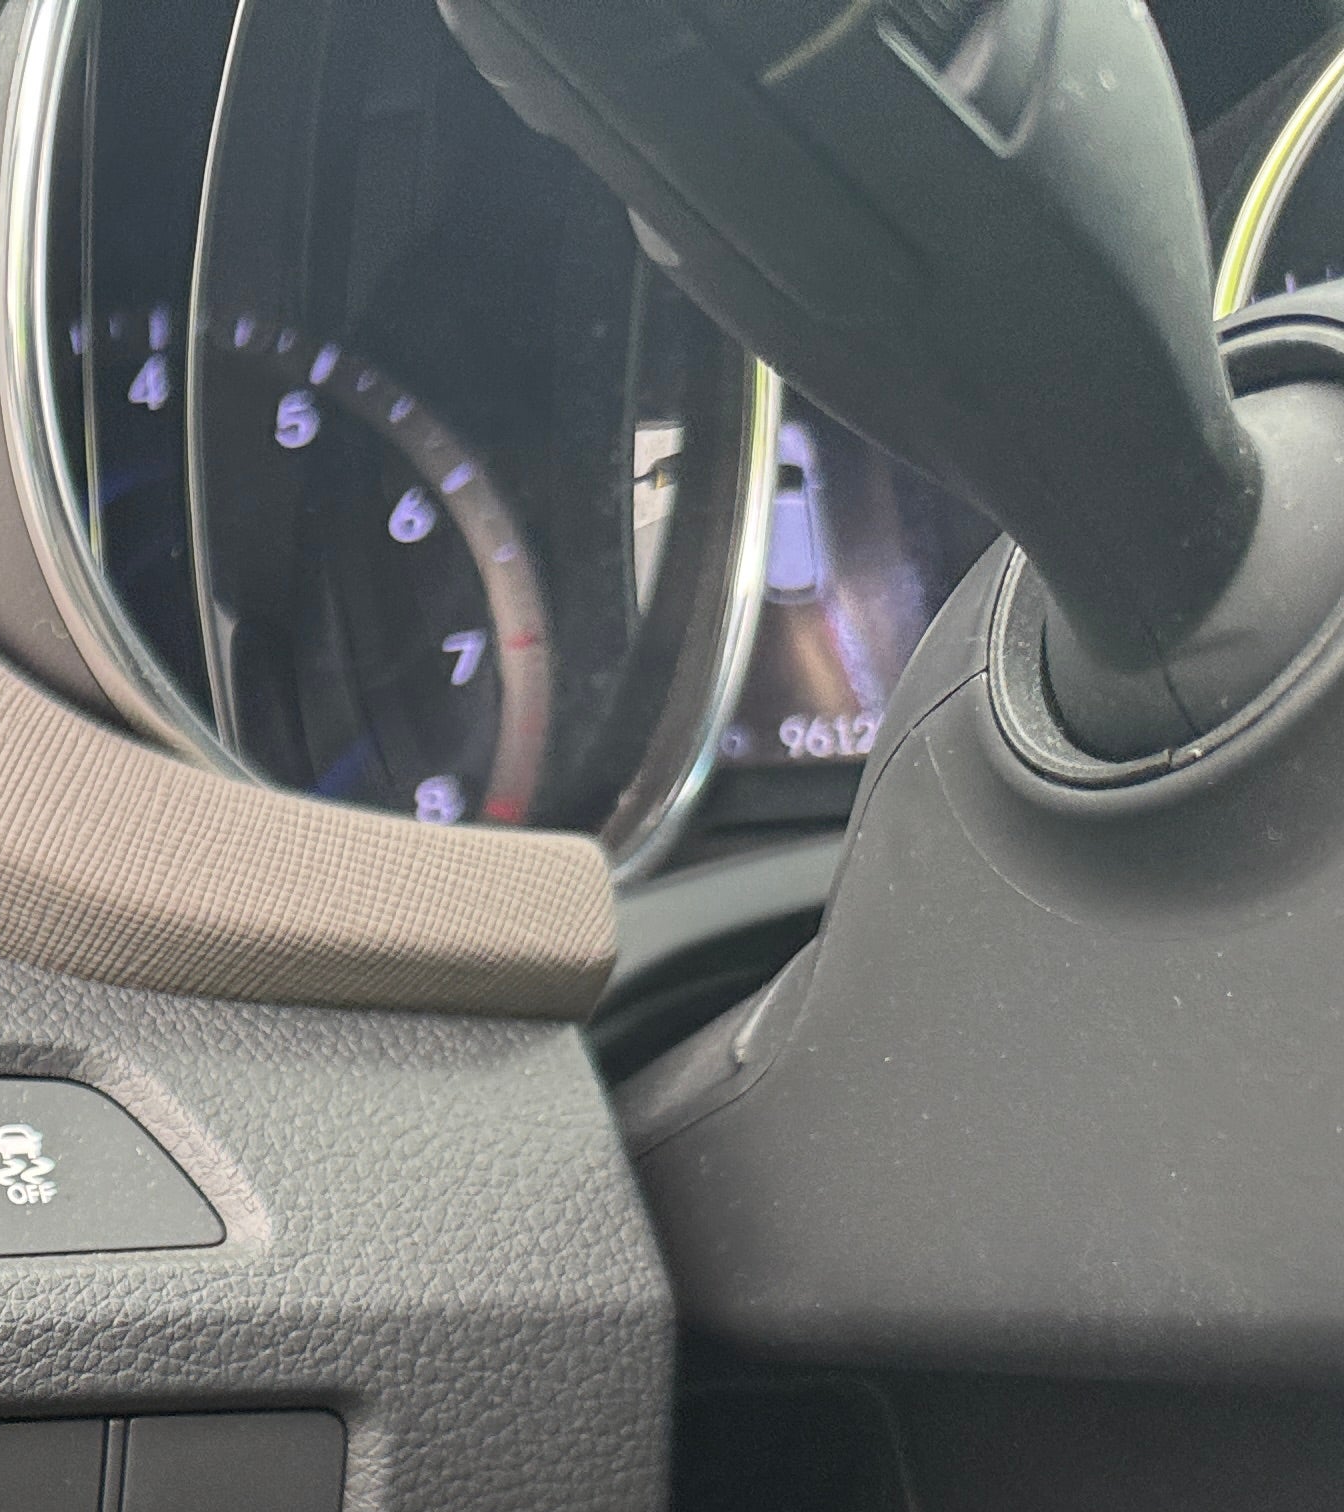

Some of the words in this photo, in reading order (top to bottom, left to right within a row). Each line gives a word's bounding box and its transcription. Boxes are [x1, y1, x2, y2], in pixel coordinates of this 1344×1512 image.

[127, 353, 169, 411] 4
[274, 388, 320, 449] 5
[388, 486, 436, 544] 6
[442, 629, 487, 686] 7
[414, 775, 464, 826] 8
[7, 1181, 58, 1205] OFF
